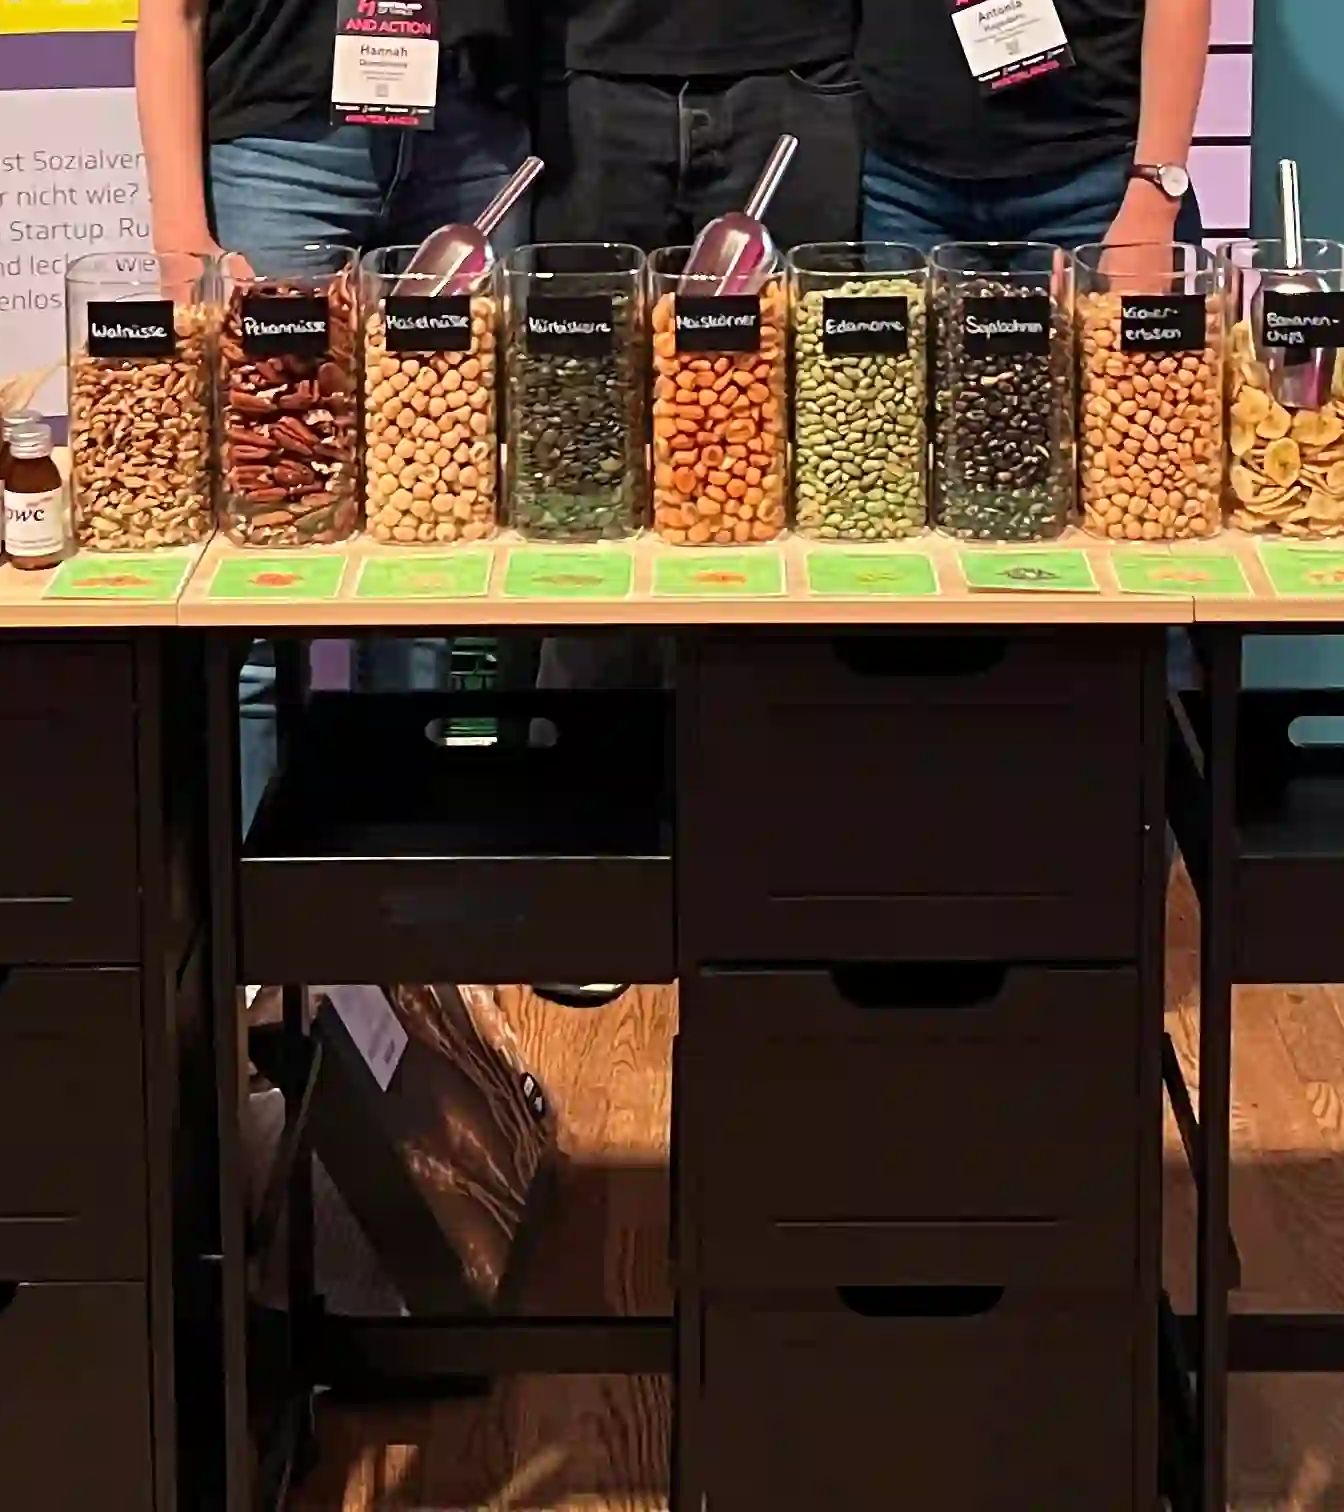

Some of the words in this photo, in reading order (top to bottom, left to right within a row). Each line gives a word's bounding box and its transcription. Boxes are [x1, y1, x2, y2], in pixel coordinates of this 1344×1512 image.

[345, 18, 378, 31] AND
[378, 20, 432, 36] ACTION
[360, 43, 409, 57] Hannah
[17, 183, 78, 206] nicht
[86, 182, 139, 205] wie?
